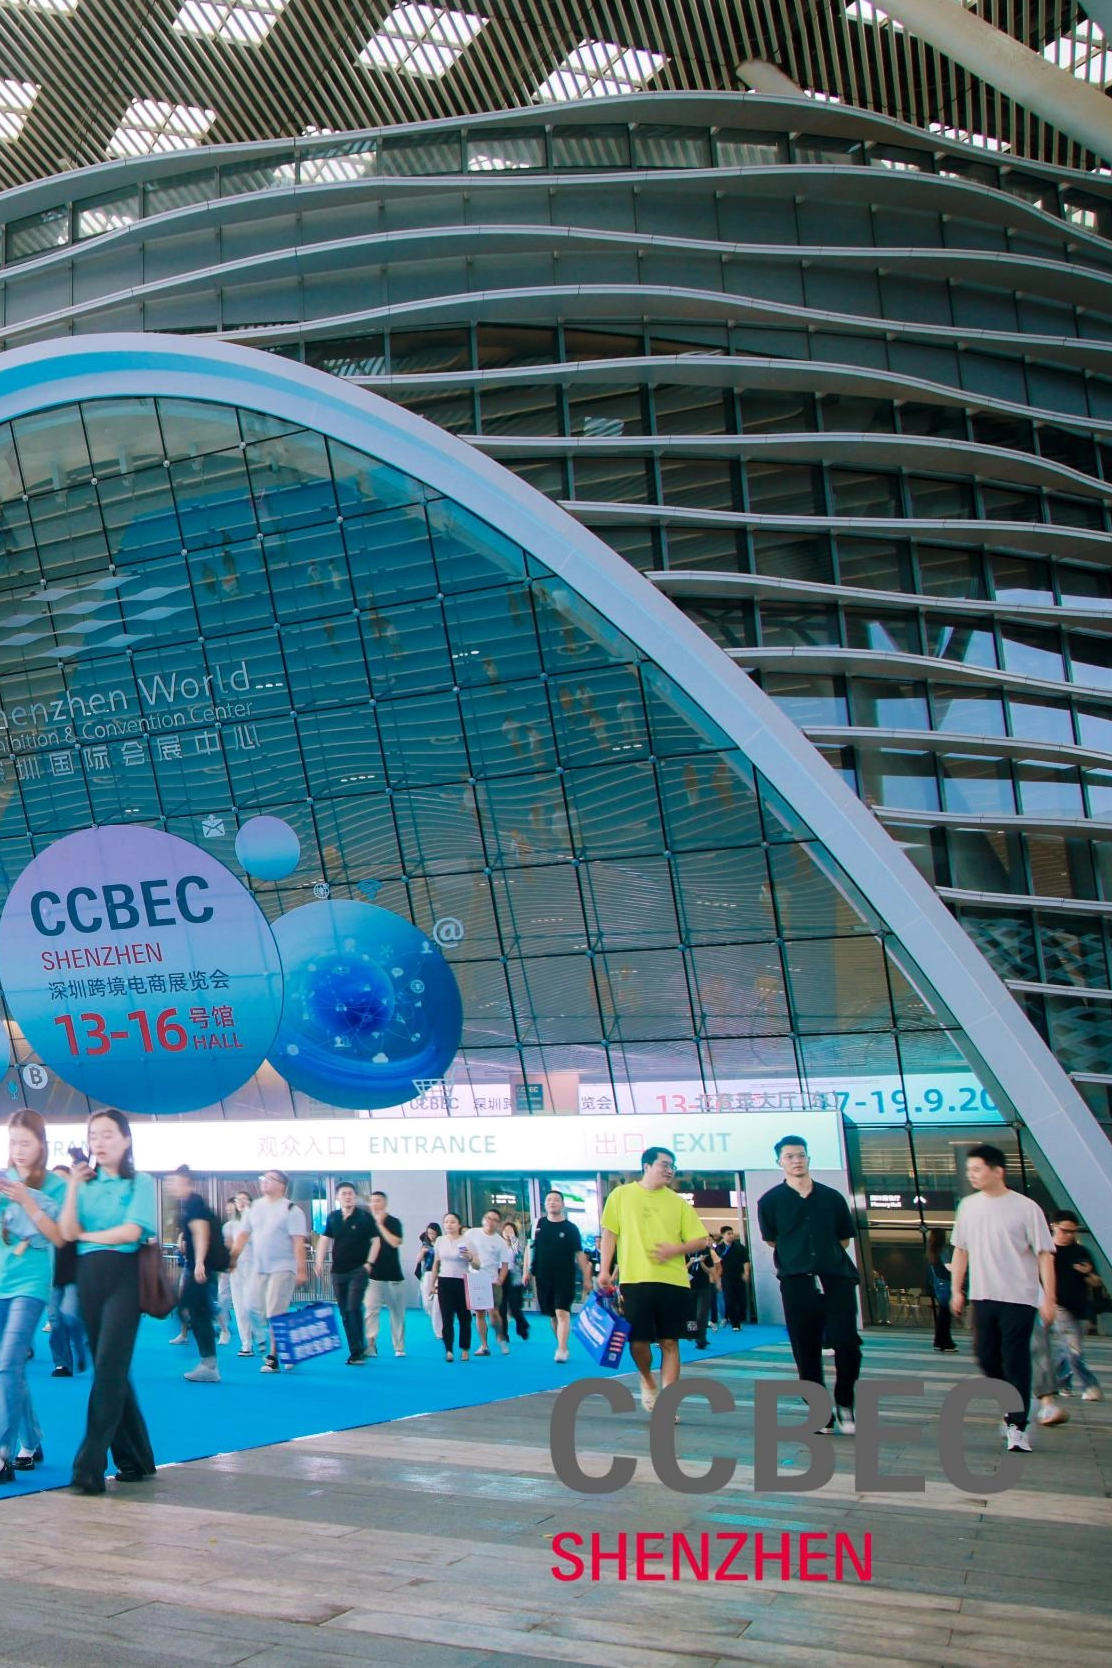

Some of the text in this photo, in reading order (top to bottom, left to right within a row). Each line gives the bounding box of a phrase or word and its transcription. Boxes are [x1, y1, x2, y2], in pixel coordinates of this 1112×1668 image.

[138, 661, 250, 706] World
[65, 728, 78, 743] &
[83, 711, 186, 740] Convention
[190, 699, 253, 723] Center
[30, 876, 214, 937] CCBEC
[41, 942, 163, 970] SHENZHEN
[48, 969, 230, 1000] 深圳跨境电商展览会
[54, 1005, 236, 1056] 13-16 号馆
[193, 1033, 244, 1050] HALL
[258, 1135, 497, 1157] 观众入口 ENTRANCE
[595, 1131, 733, 1154] 出口 EXIT
